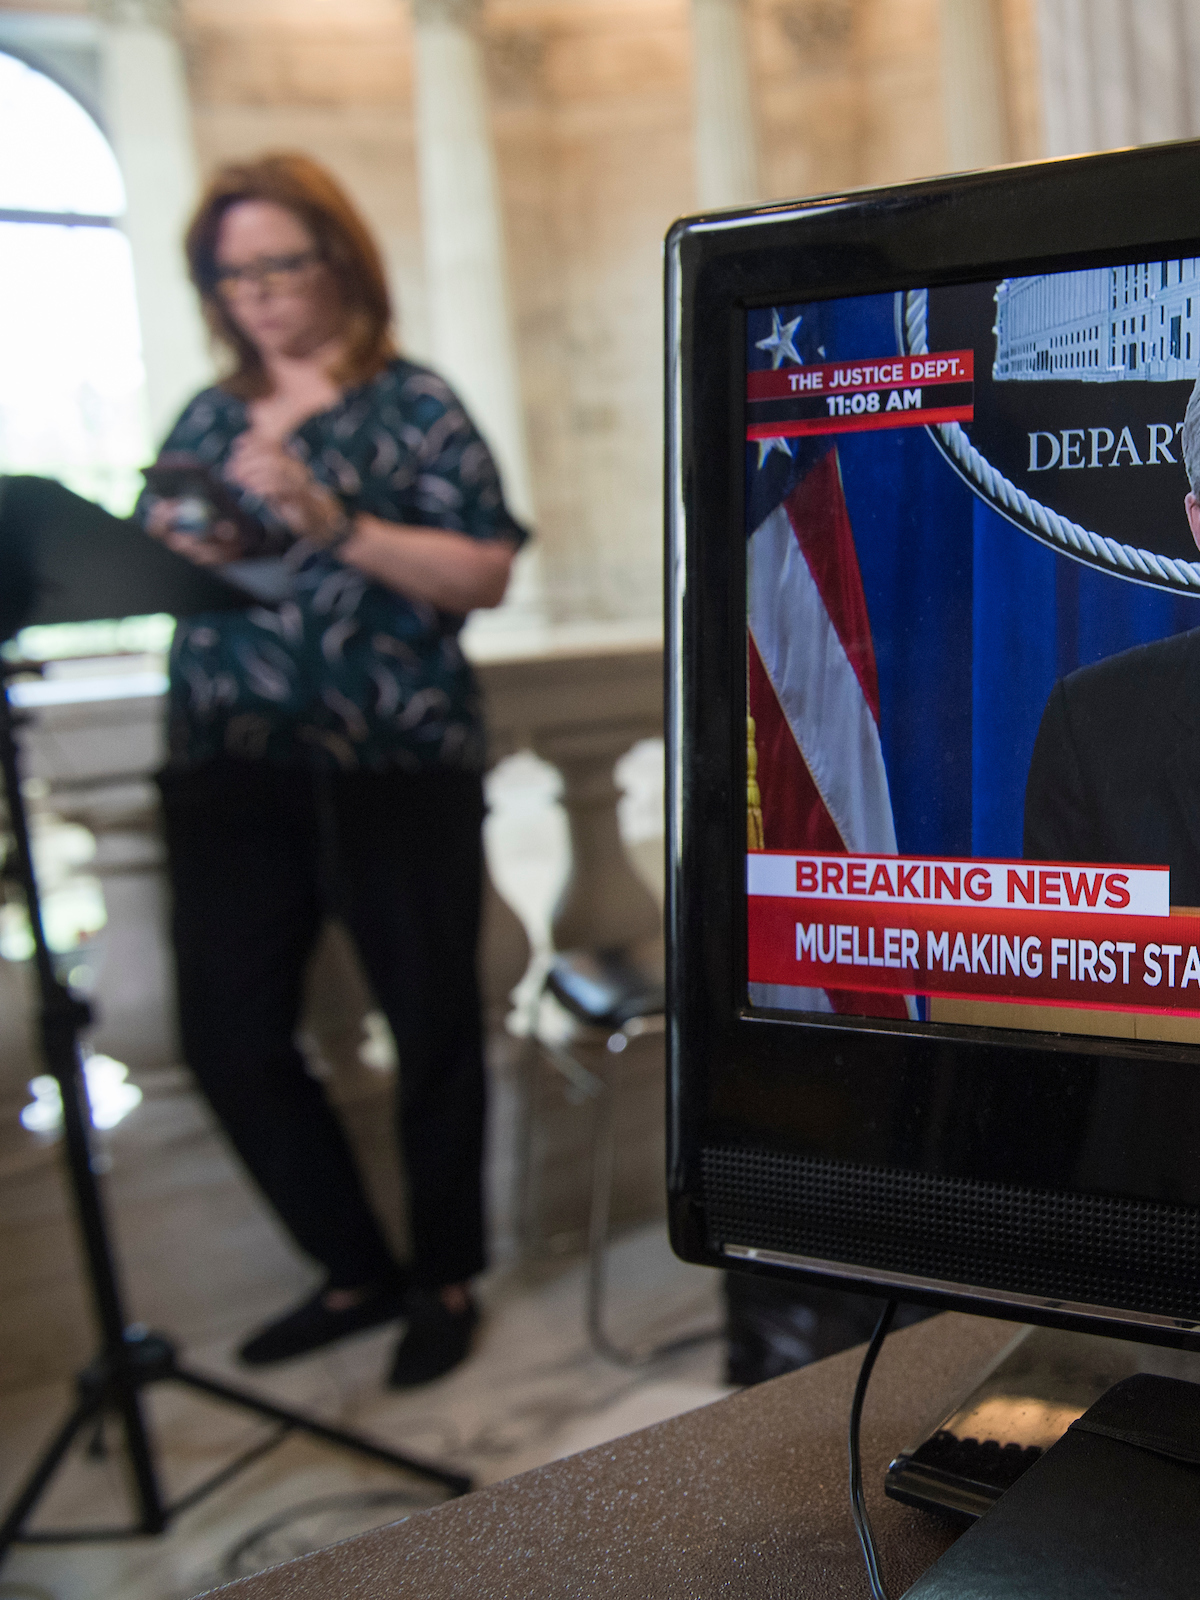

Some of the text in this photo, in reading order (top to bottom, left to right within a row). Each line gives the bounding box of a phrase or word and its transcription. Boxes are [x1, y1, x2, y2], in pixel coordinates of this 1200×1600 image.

[788, 358, 965, 391] THE JUSTICE DEPT.
[826, 388, 922, 416] 11:08 AM
[796, 860, 1131, 909] BREAKING NEWS
[795, 922, 920, 970] MUELLER
[926, 931, 1043, 979] MAKING
[1050, 938, 1137, 985] FIRST
